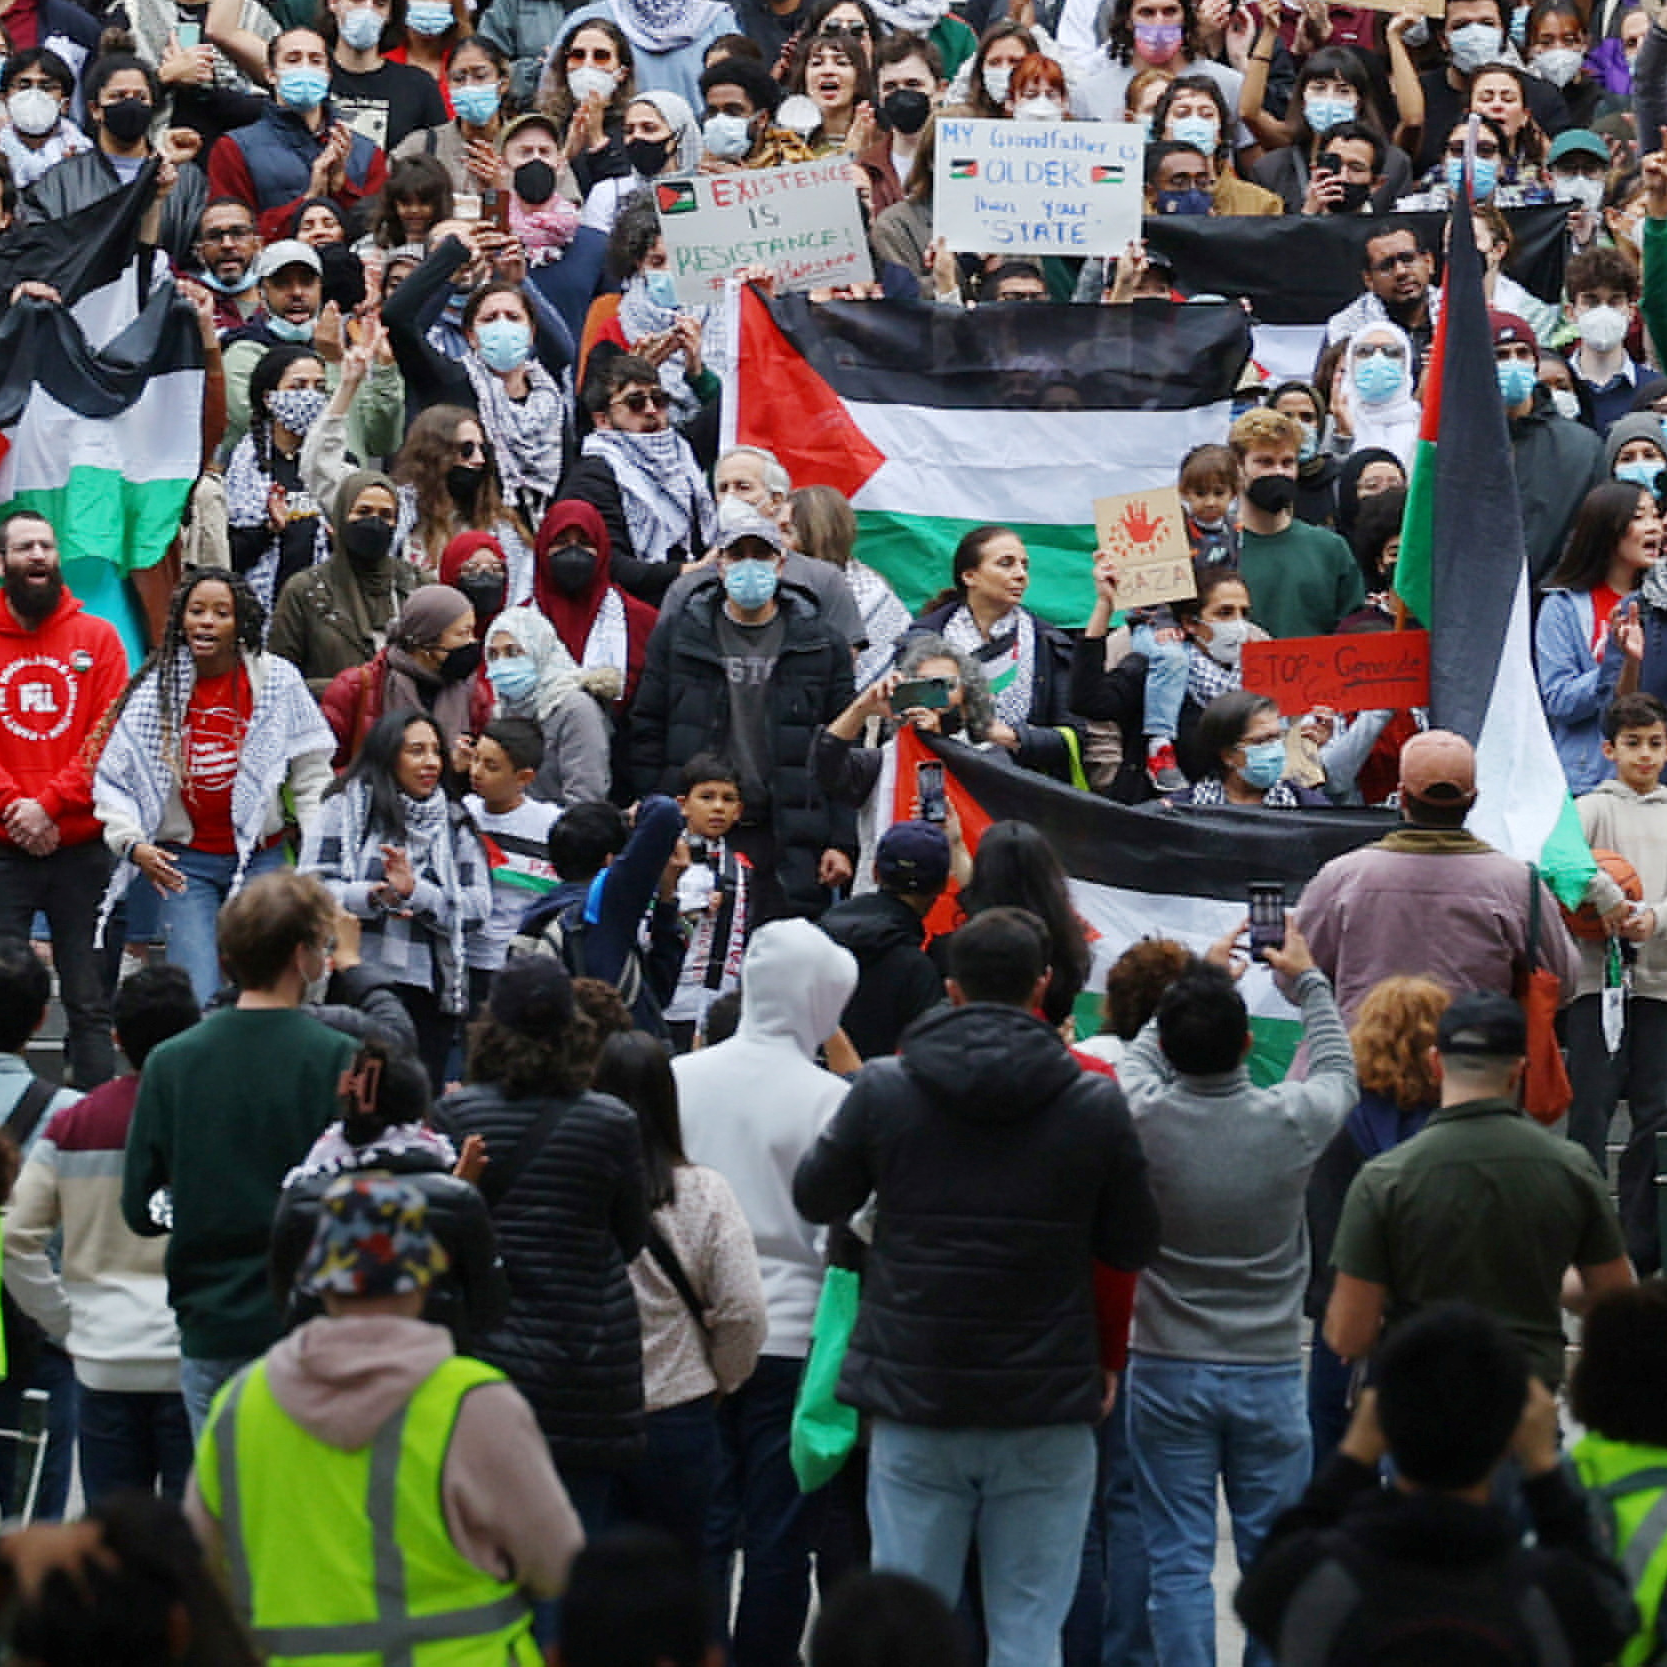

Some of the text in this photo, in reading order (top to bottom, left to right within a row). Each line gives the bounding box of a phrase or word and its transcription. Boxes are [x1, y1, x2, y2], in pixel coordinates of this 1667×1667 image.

[942, 123, 974, 146] MY
[710, 163, 853, 208] EXISTENCE
[984, 159, 1086, 189] OLDER
[748, 204, 781, 230] IS
